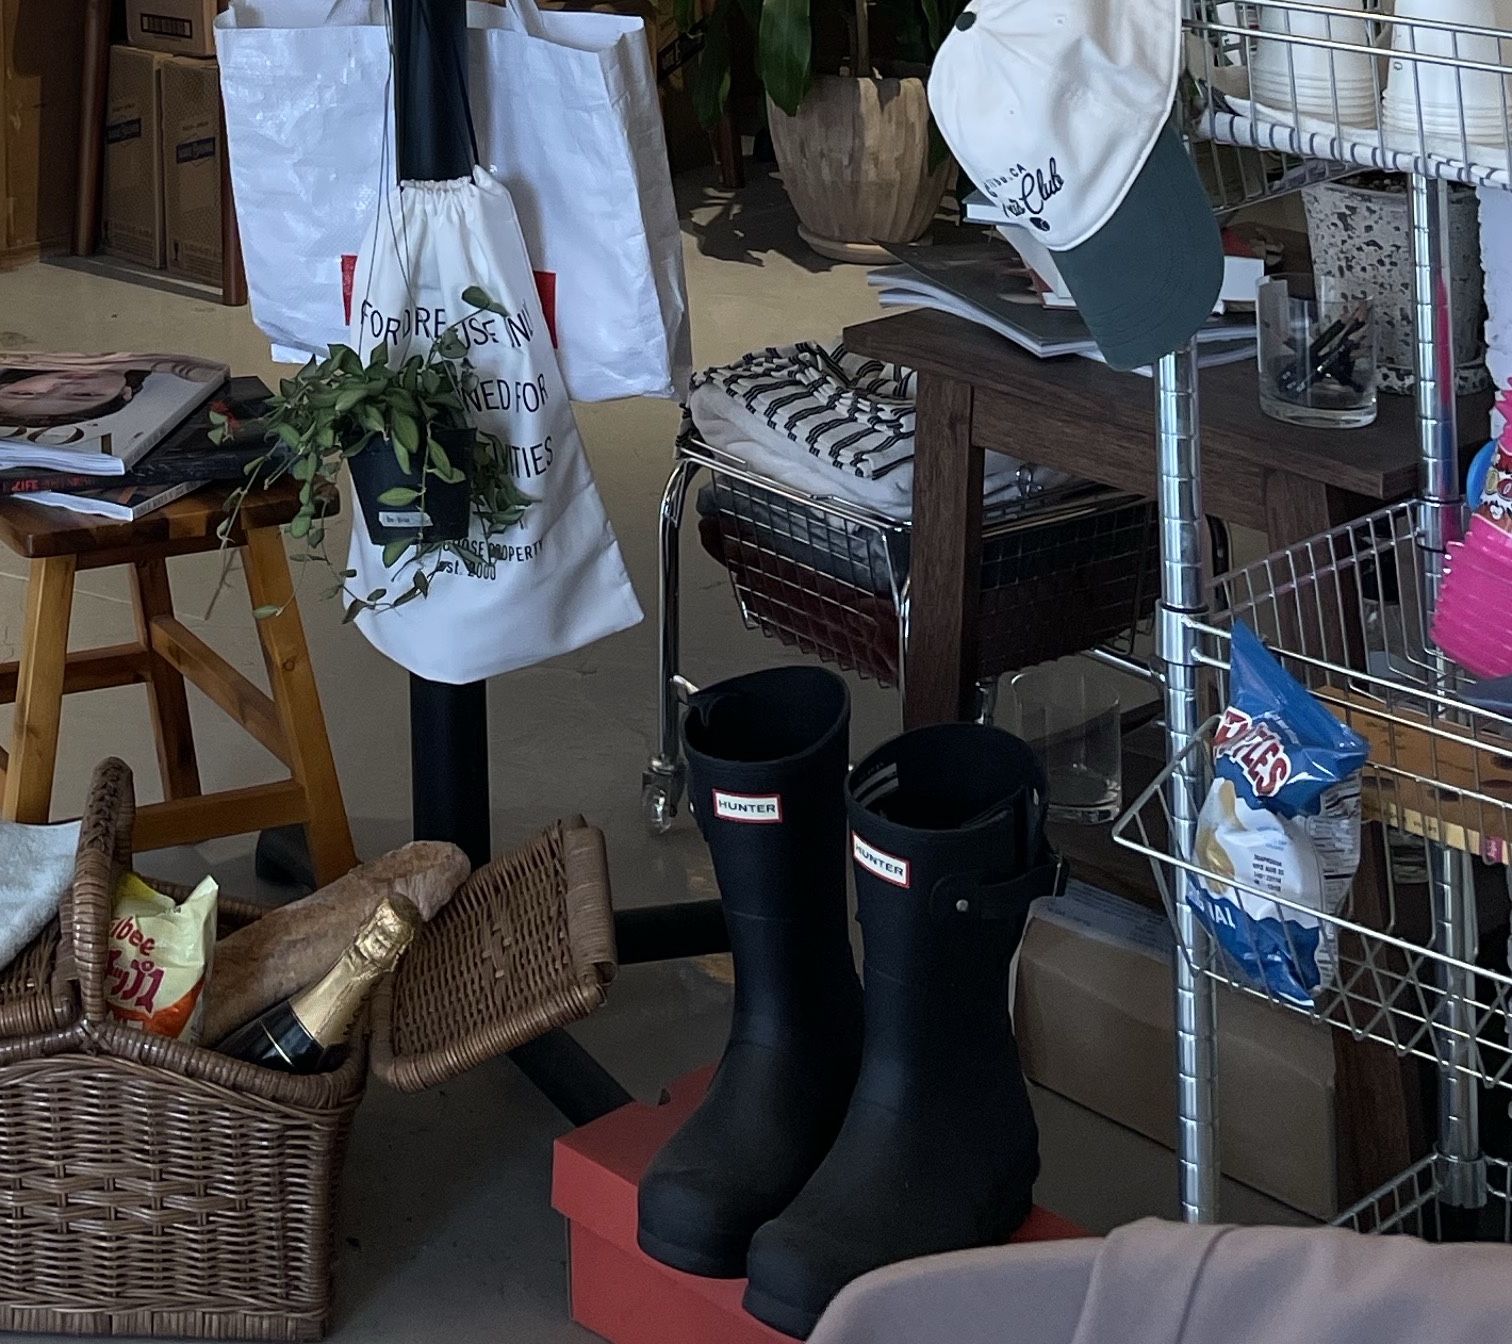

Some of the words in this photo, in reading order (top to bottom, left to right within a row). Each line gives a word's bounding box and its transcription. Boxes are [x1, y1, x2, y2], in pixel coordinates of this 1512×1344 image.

[1018, 156, 1065, 215] Club
[515, 373, 550, 413] FOR
[718, 798, 776, 814] HUNTER
[855, 842, 904, 878] HUNTER
